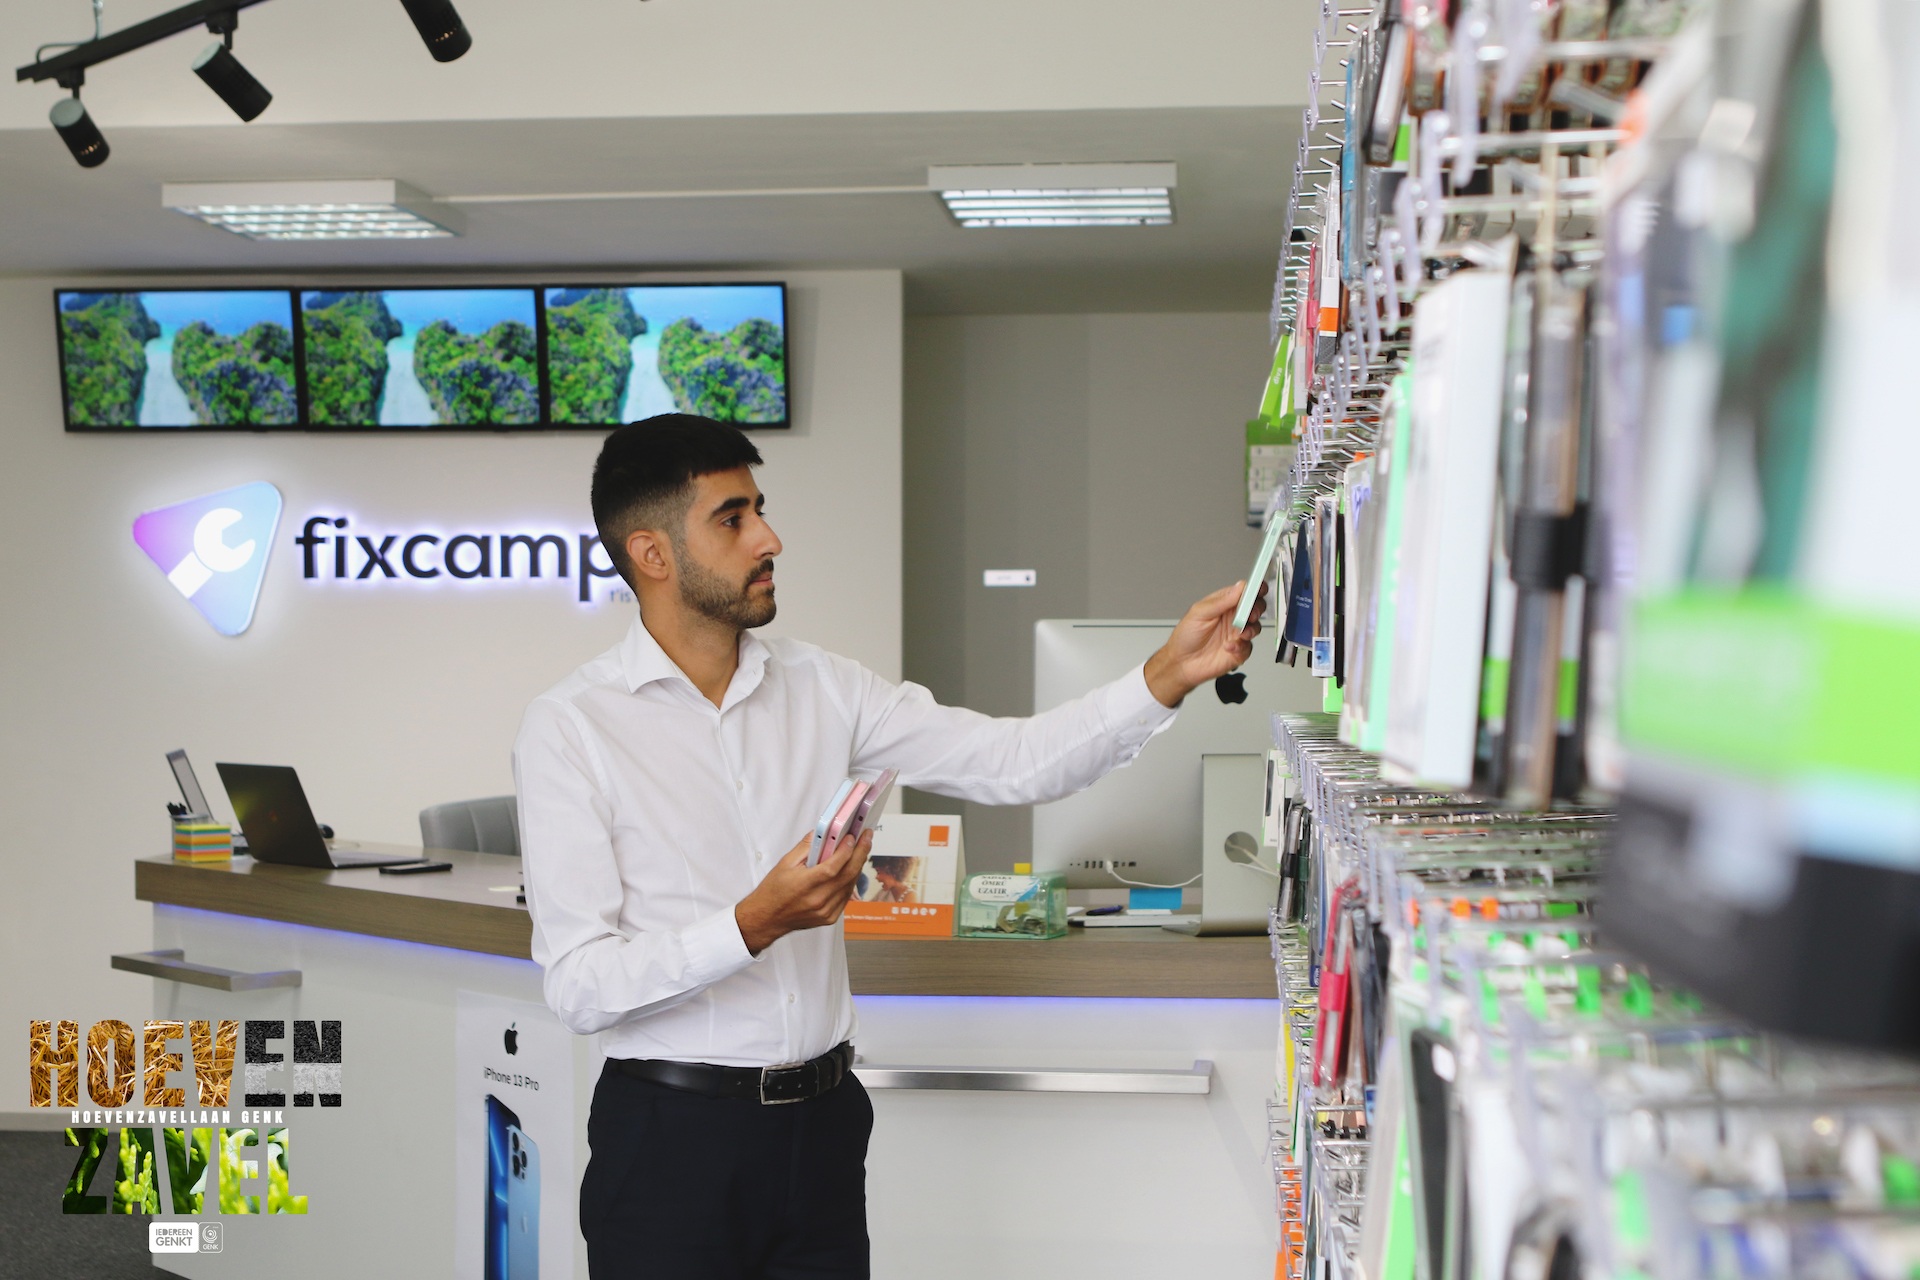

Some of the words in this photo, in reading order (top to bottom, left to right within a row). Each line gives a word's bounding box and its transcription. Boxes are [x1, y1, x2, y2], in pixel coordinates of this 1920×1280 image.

[978, 887, 1007, 895] UZATIR
[484, 1066, 511, 1084] iPhone
[513, 1074, 523, 1087] 13
[525, 1076, 540, 1091] Pro
